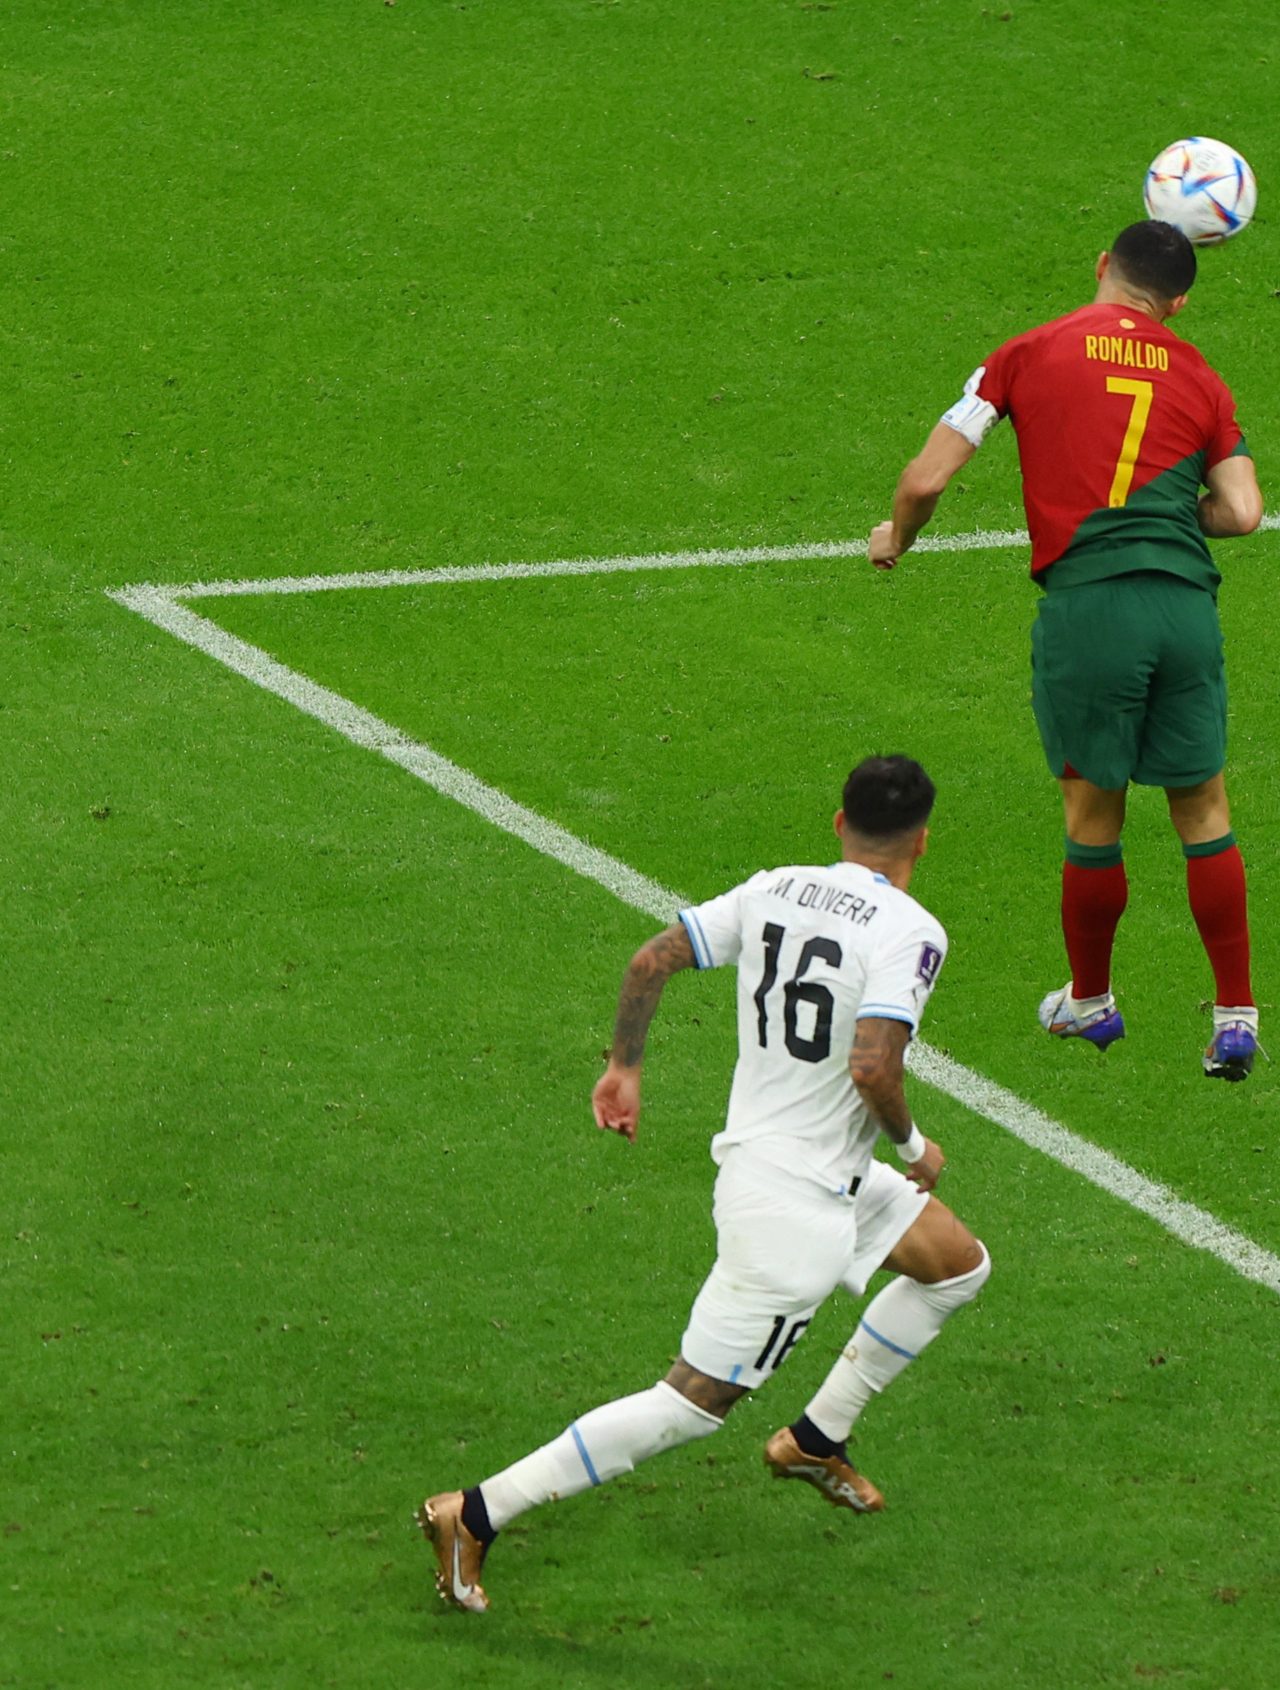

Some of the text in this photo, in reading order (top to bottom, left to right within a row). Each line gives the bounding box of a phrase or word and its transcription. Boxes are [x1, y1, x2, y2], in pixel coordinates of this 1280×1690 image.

[1085, 334, 1169, 372] RONALDO
[1105, 375, 1153, 508] 7
[767, 877, 878, 926] M. OLIVERA
[754, 921, 843, 1064] 16
